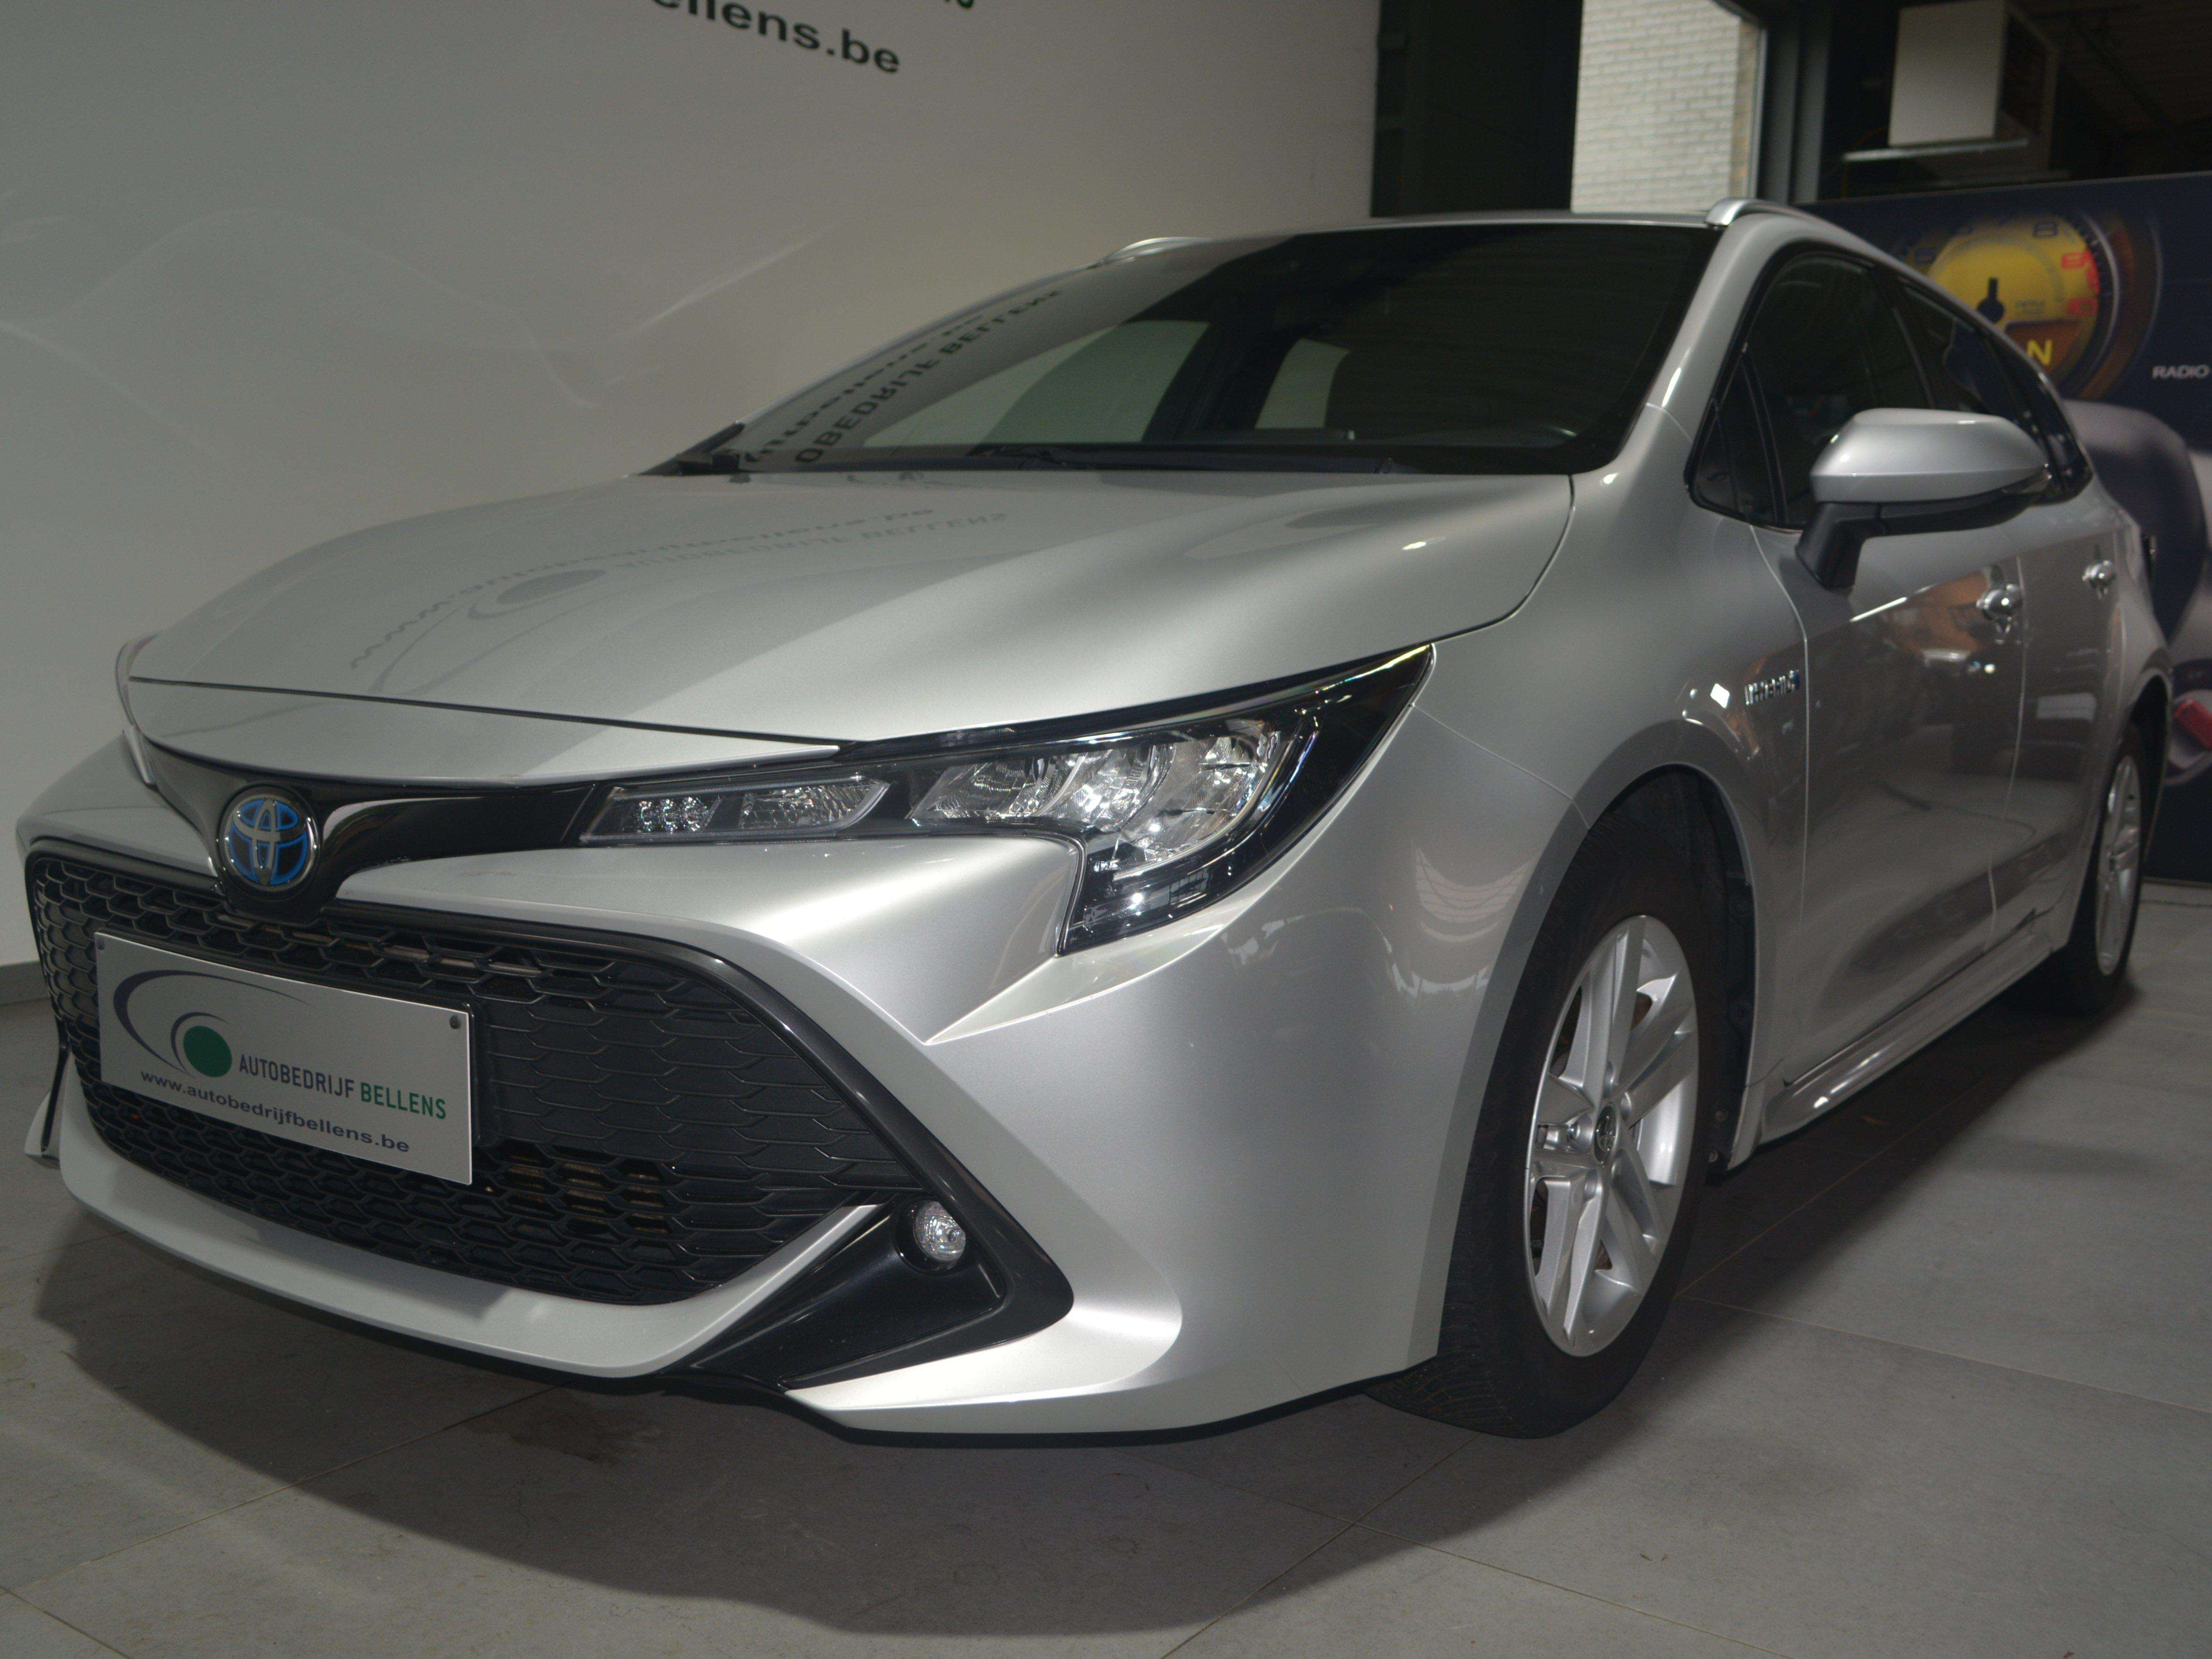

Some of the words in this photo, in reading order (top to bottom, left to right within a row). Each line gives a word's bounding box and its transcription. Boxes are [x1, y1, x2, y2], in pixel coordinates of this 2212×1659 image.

[653, 0, 900, 73] lens.be
[2152, 364, 2210, 380] RADIO
[141, 1070, 410, 1152] www.autobedrijfbellens.be
[239, 1054, 354, 1098] AUTOBEDRIJF
[361, 1082, 446, 1119] BELLENS
